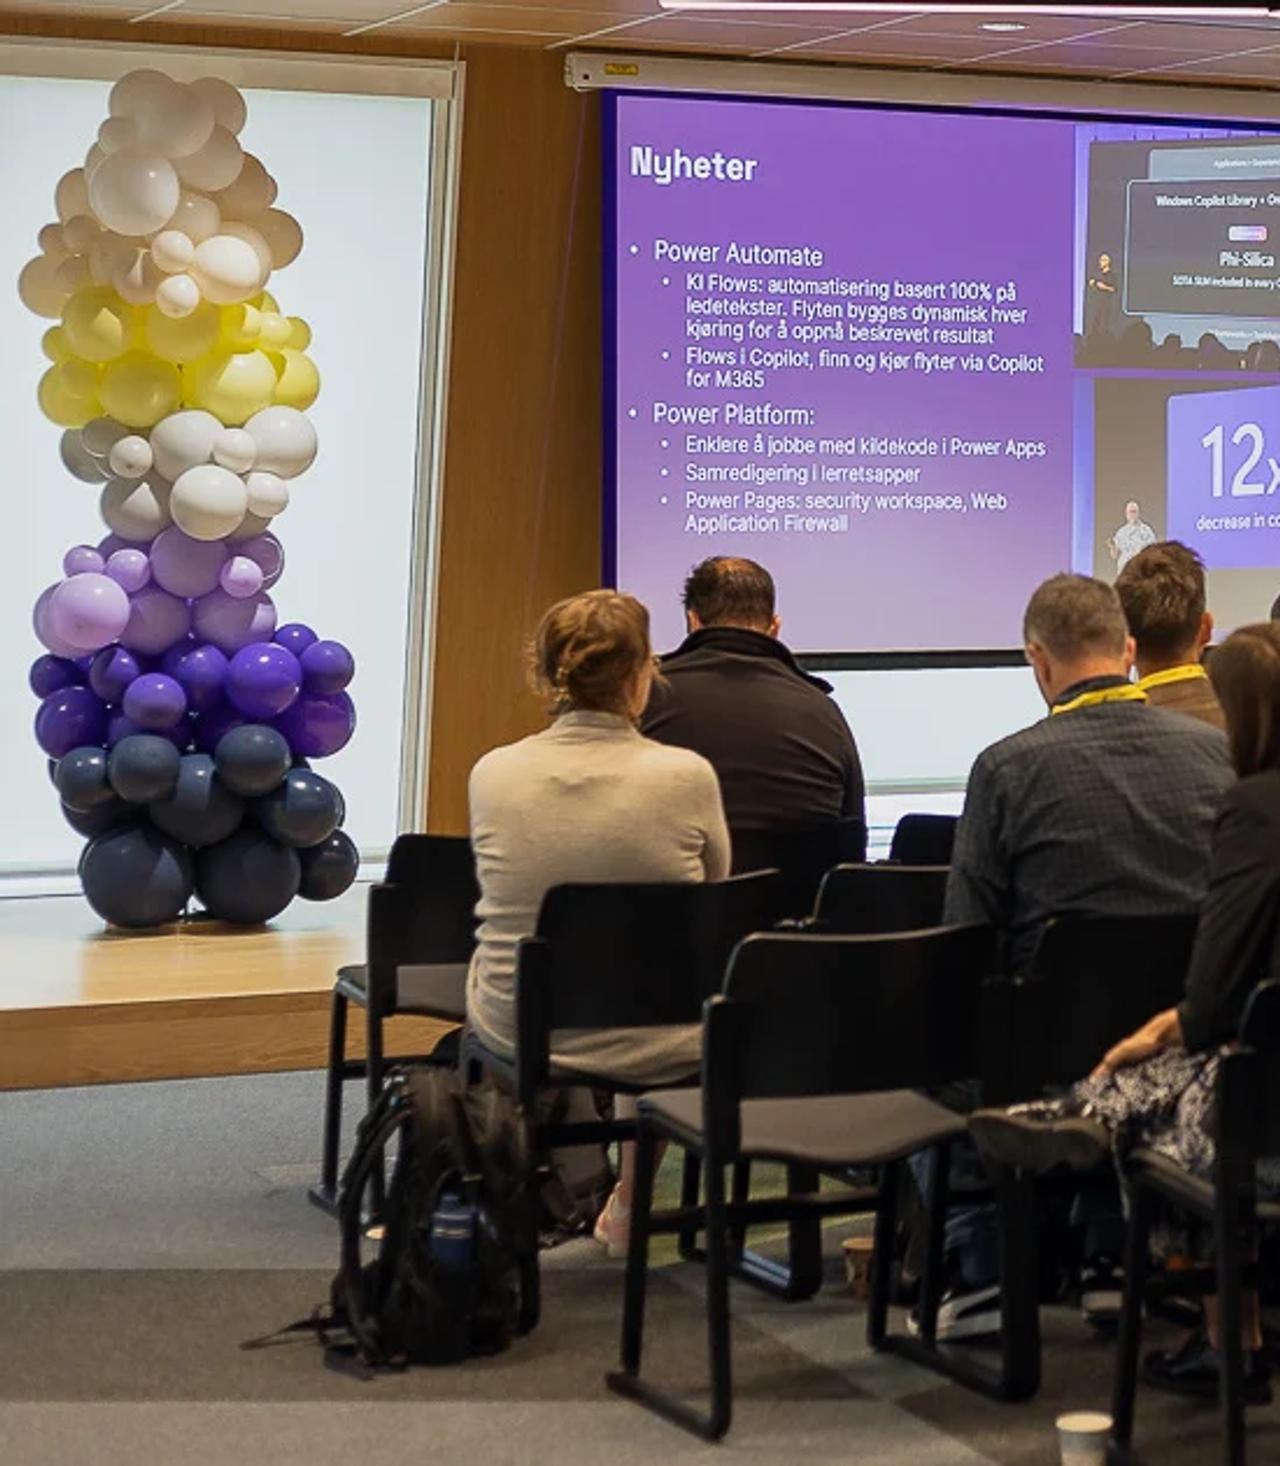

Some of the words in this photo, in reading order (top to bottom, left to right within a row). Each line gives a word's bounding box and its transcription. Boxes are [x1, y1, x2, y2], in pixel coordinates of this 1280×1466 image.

[630, 145, 757, 184] Nyheter
[655, 239, 719, 263] Power
[726, 243, 823, 267] Automate
[687, 274, 703, 292] KI
[708, 275, 763, 292] Flows:
[767, 278, 888, 300] automatisering
[894, 281, 946, 299] basert
[949, 282, 991, 300] 100%
[997, 281, 1016, 303] på
[687, 298, 787, 316] ledetekster.
[792, 301, 842, 322] Flyten
[847, 302, 906, 323] bygges
[912, 304, 988, 325] dynamisk
[992, 307, 1027, 324] hver
[686, 321, 743, 341] kjøring
[748, 321, 772, 339] for
[777, 319, 787, 340] å
[793, 321, 844, 343] oppnå
[849, 324, 929, 343] beskrevet
[933, 327, 994, 344] resultat
[687, 348, 736, 366] Flows
[750, 349, 814, 370] Copilot,
[819, 350, 849, 367] finn
[854, 353, 874, 372] og
[880, 352, 909, 373] kjør
[913, 352, 956, 373] flyter
[960, 355, 983, 371] via
[988, 355, 1043, 376] Copilot
[687, 370, 711, 388] for
[715, 371, 764, 388] M365
[654, 402, 718, 423] Power
[725, 404, 814, 425] Platform:
[686, 435, 748, 453] Enklere
[754, 433, 763, 453] å
[767, 436, 815, 457] jobbe
[820, 437, 856, 455] med
[860, 438, 937, 456] kildekode
[951, 438, 1000, 456] Power
[1005, 439, 1045, 459] Apps
[686, 464, 808, 486] Samredigering
[821, 466, 920, 486] lerretsapper
[686, 492, 739, 510] Power
[744, 492, 800, 513] Pages:
[804, 492, 870, 513] security
[875, 493, 967, 513] workspace,
[970, 493, 1007, 510] Web
[685, 514, 779, 534] Application
[784, 515, 849, 531] Firewall
[1197, 514, 1251, 530] decrease
[1254, 512, 1266, 527] in
